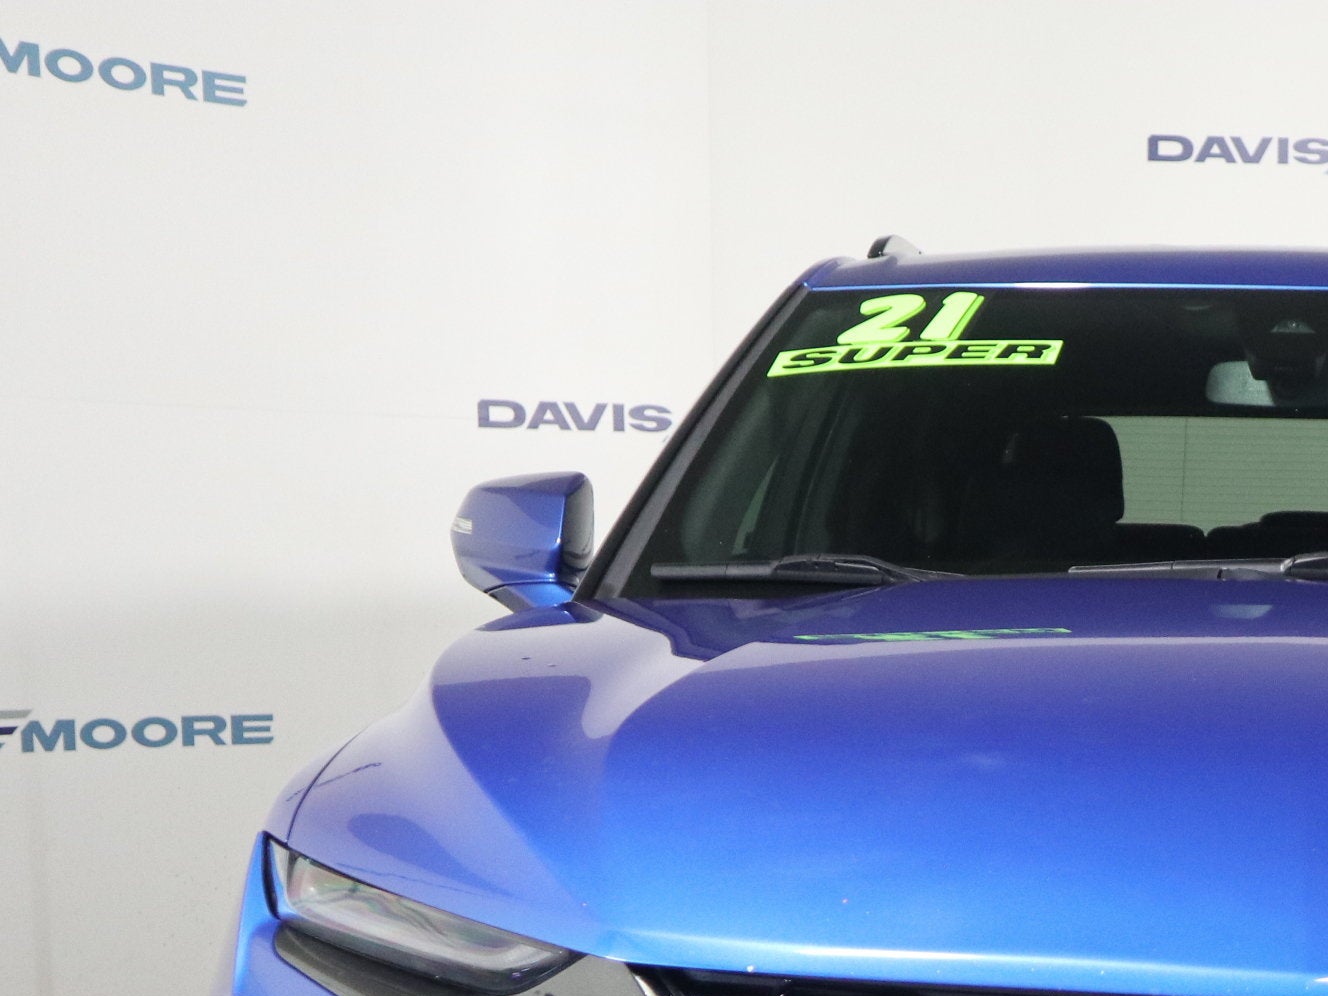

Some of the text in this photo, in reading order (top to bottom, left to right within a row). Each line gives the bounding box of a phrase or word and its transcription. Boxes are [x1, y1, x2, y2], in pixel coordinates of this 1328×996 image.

[0, 37, 248, 107] MOORE
[836, 291, 985, 345] 21
[781, 343, 1053, 369] SUPER
[477, 399, 673, 432] DAVIS
[20, 713, 275, 753] MOORE
